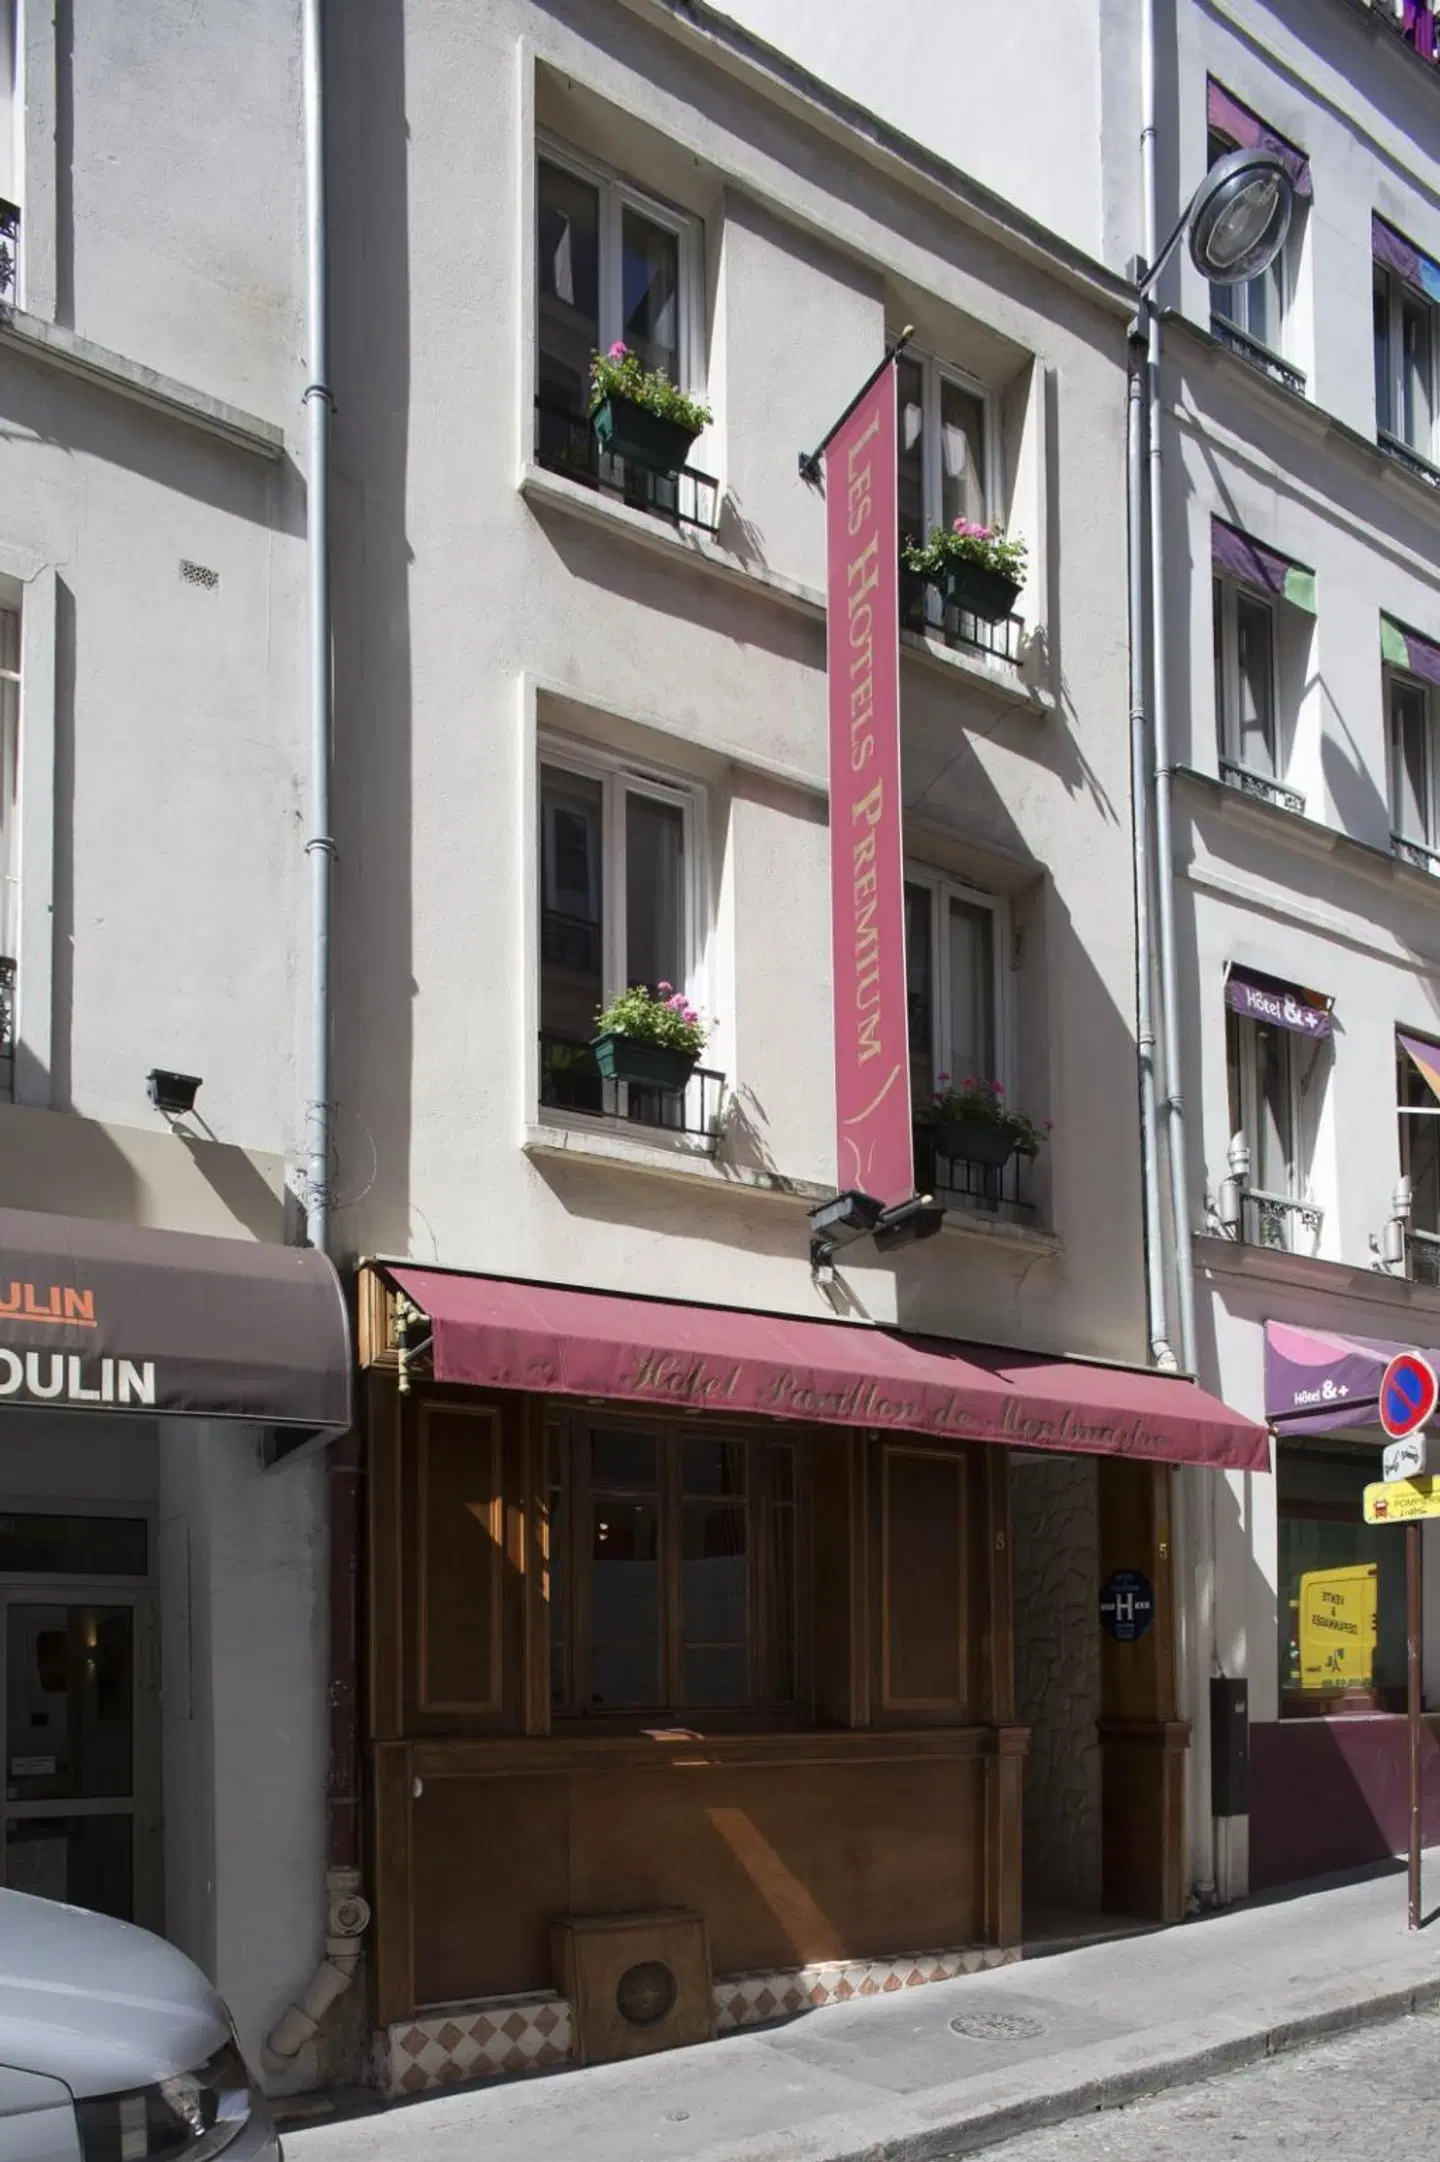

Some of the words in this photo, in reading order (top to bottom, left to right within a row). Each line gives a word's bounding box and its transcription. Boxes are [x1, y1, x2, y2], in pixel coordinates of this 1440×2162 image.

[848, 408, 880, 537] LES
[848, 529, 880, 772] HOTELS
[852, 775, 883, 1069] PREMIUM
[1245, 988, 1281, 1020] Hôtel
[934, 1393, 972, 1426] de
[1115, 1592, 1134, 1621] H
